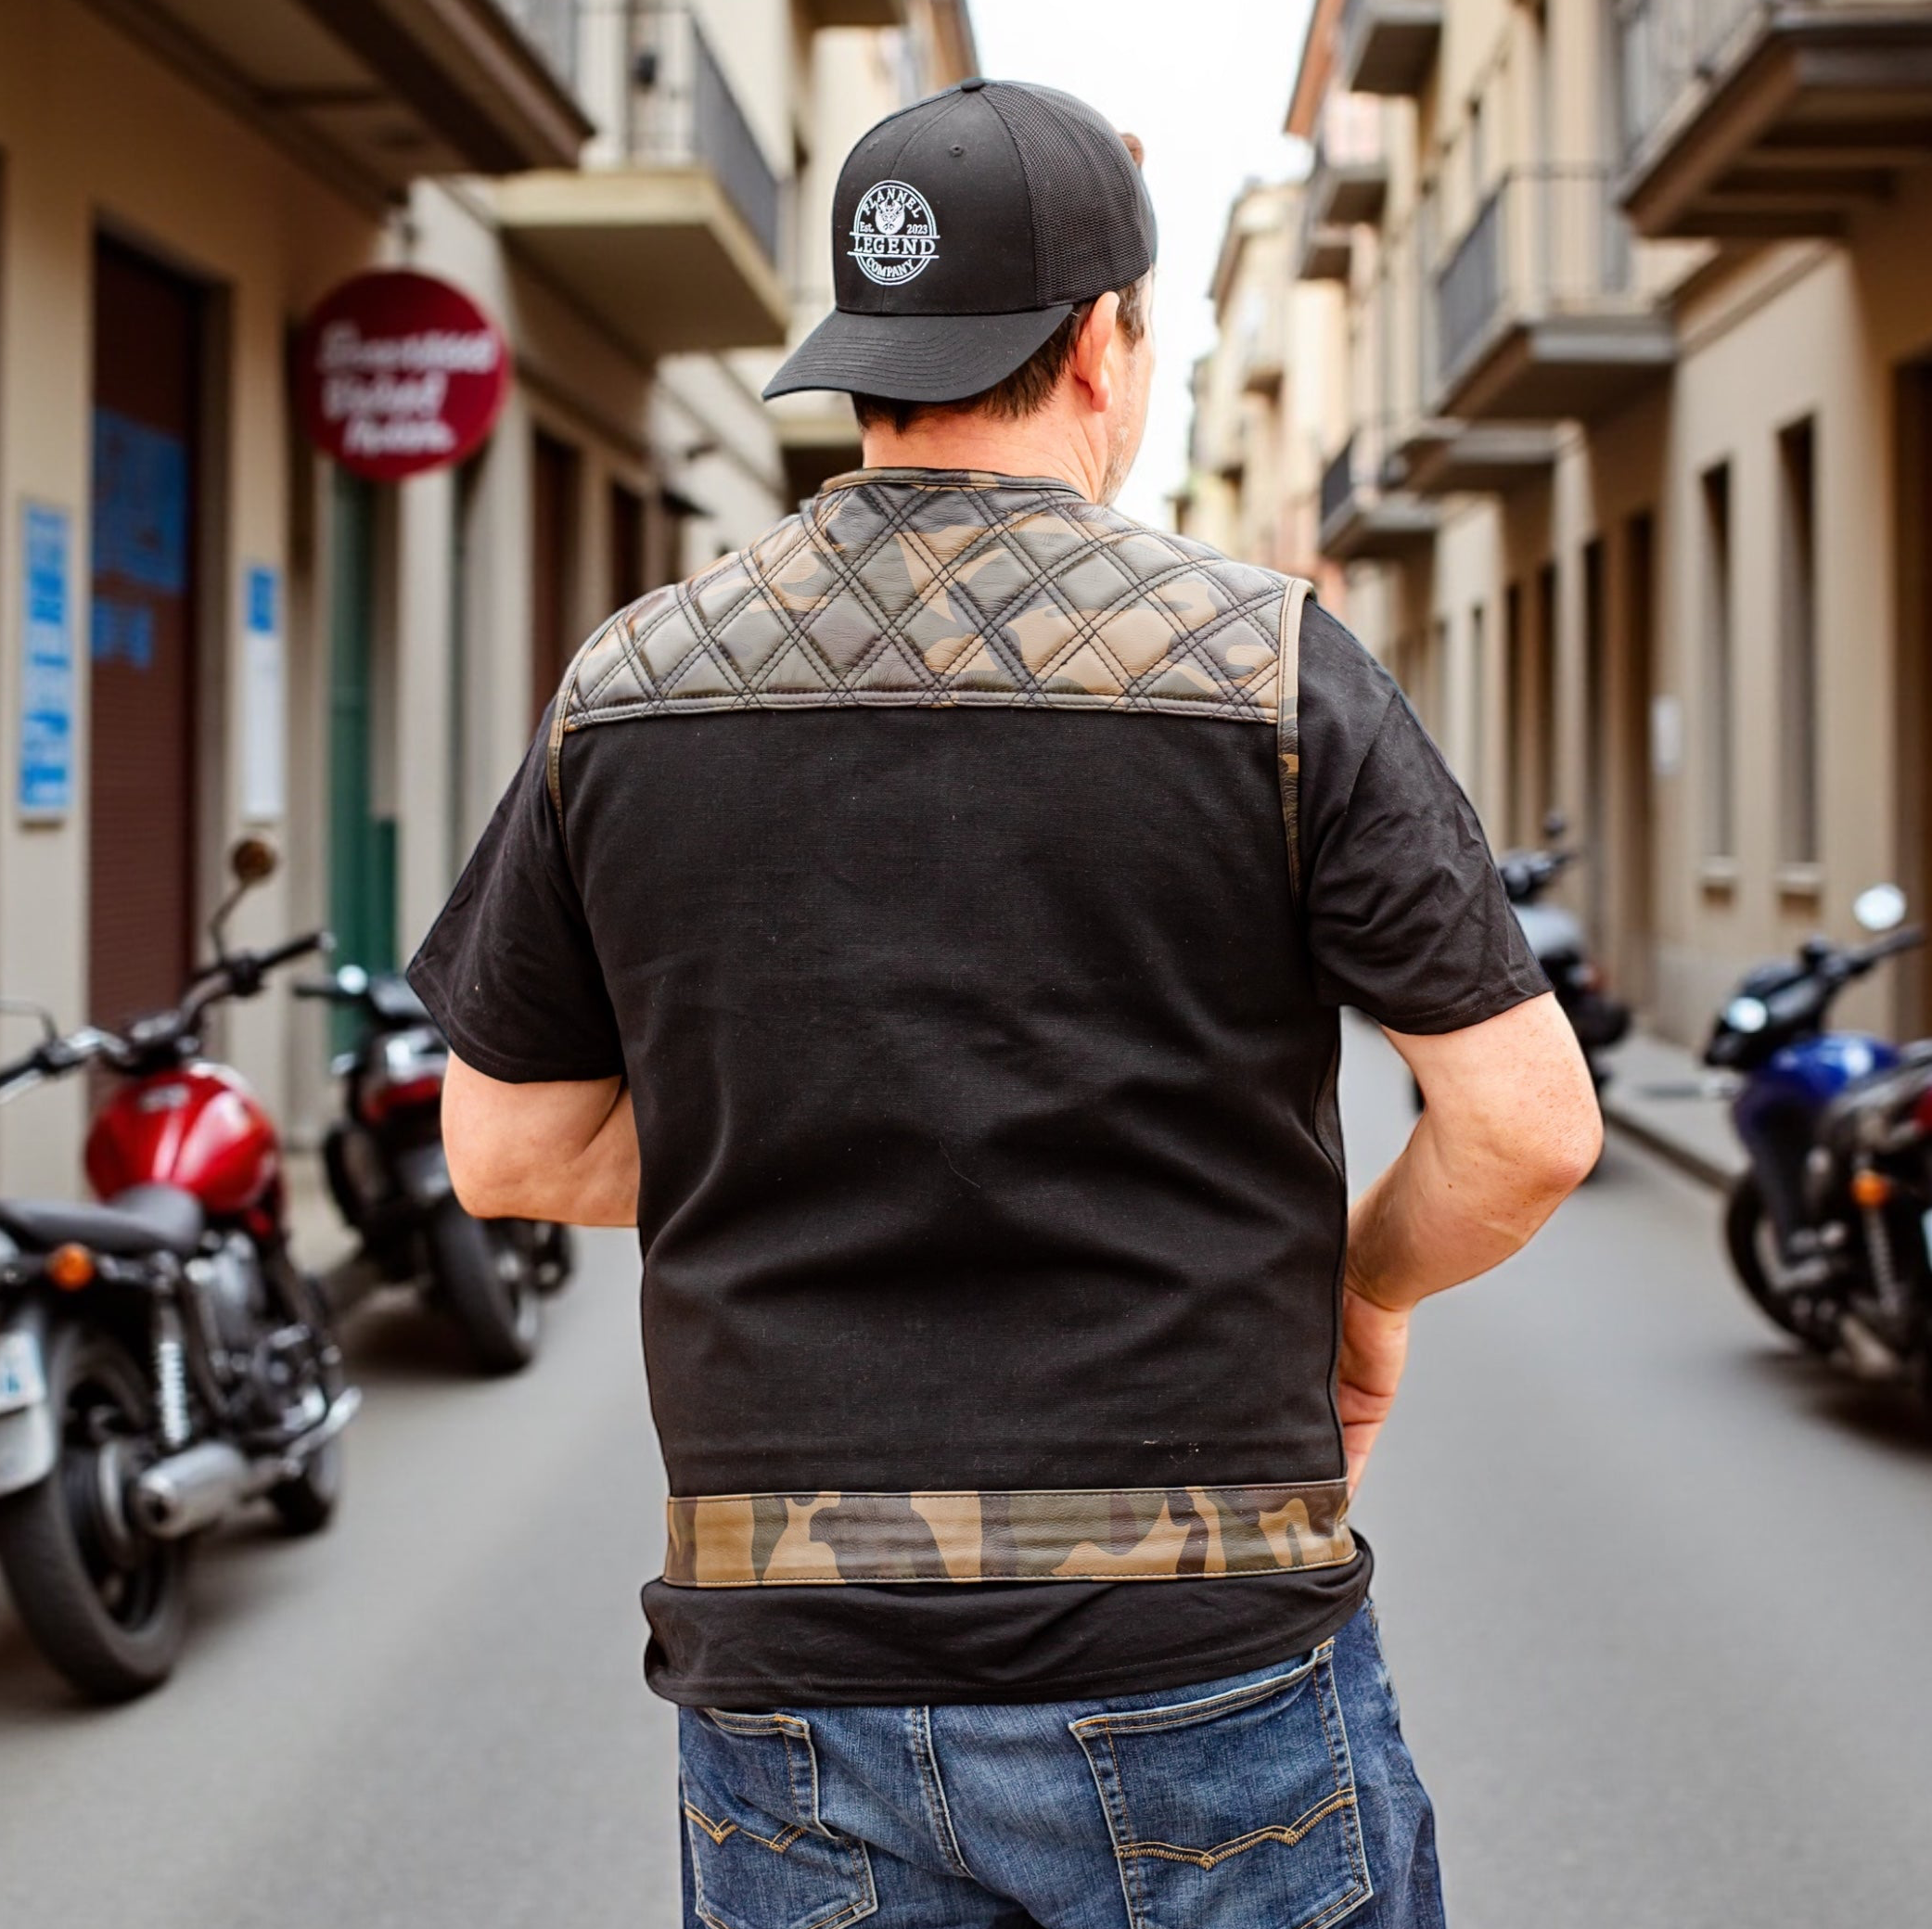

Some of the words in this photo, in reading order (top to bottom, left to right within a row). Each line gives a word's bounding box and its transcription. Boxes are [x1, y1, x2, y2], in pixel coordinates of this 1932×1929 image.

[862, 188, 923, 218] FLANNEL
[859, 222, 875, 233] Est.
[906, 224, 928, 235] 2023
[853, 236, 936, 255] LEGEND
[866, 257, 915, 277] COMPANY
